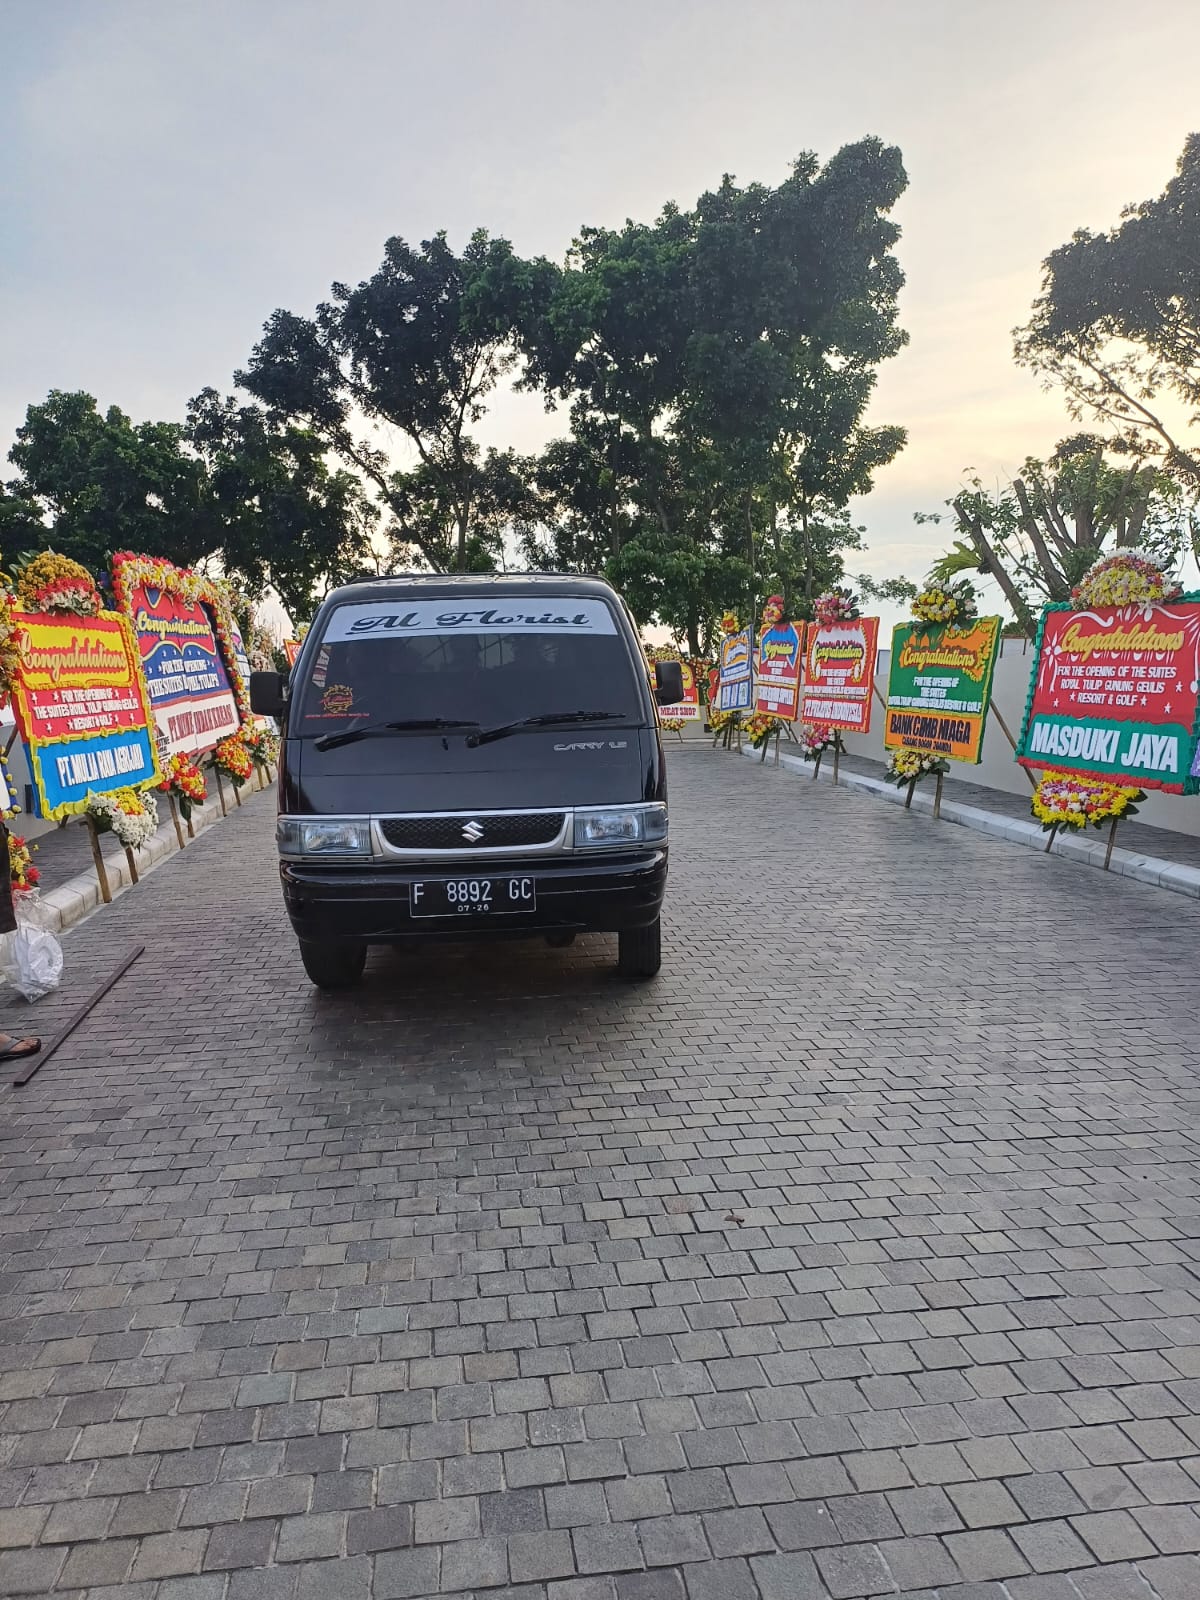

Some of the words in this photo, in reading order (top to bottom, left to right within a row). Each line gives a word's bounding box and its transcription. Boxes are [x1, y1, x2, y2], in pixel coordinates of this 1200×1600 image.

[350, 611, 421, 632] Al
[435, 609, 591, 627] Florist
[1061, 623, 1185, 662] Congratulations
[18, 631, 127, 682] Congratulations
[903, 646, 975, 671] Congratulations
[1057, 666, 1072, 676] FOR
[1072, 666, 1085, 676] THE
[1085, 666, 1116, 677] OPENING
[1117, 666, 1130, 677] OF
[1131, 666, 1148, 678] THE
[1147, 666, 1177, 678] SUITES
[1060, 679, 1081, 690] ROYAL
[1083, 679, 1103, 691] TULIP
[1105, 680, 1134, 692] GUNUNG
[1136, 682, 1166, 693] GEULIS
[660, 707, 679, 716] MEAT
[680, 707, 697, 716] SHOP
[1077, 693, 1106, 704] RESORT
[1107, 694, 1113, 705] &
[1115, 694, 1138, 706] GOLF
[890, 713, 914, 736] BANK
[913, 715, 938, 738] CIMB
[938, 718, 971, 744] NIAGA
[553, 741, 605, 751] CARRY
[1030, 722, 1121, 763] MASDUKI
[1121, 732, 1178, 773] JAYA
[413, 883, 424, 904] F
[446, 880, 493, 902] 8892
[508, 879, 531, 899] GC
